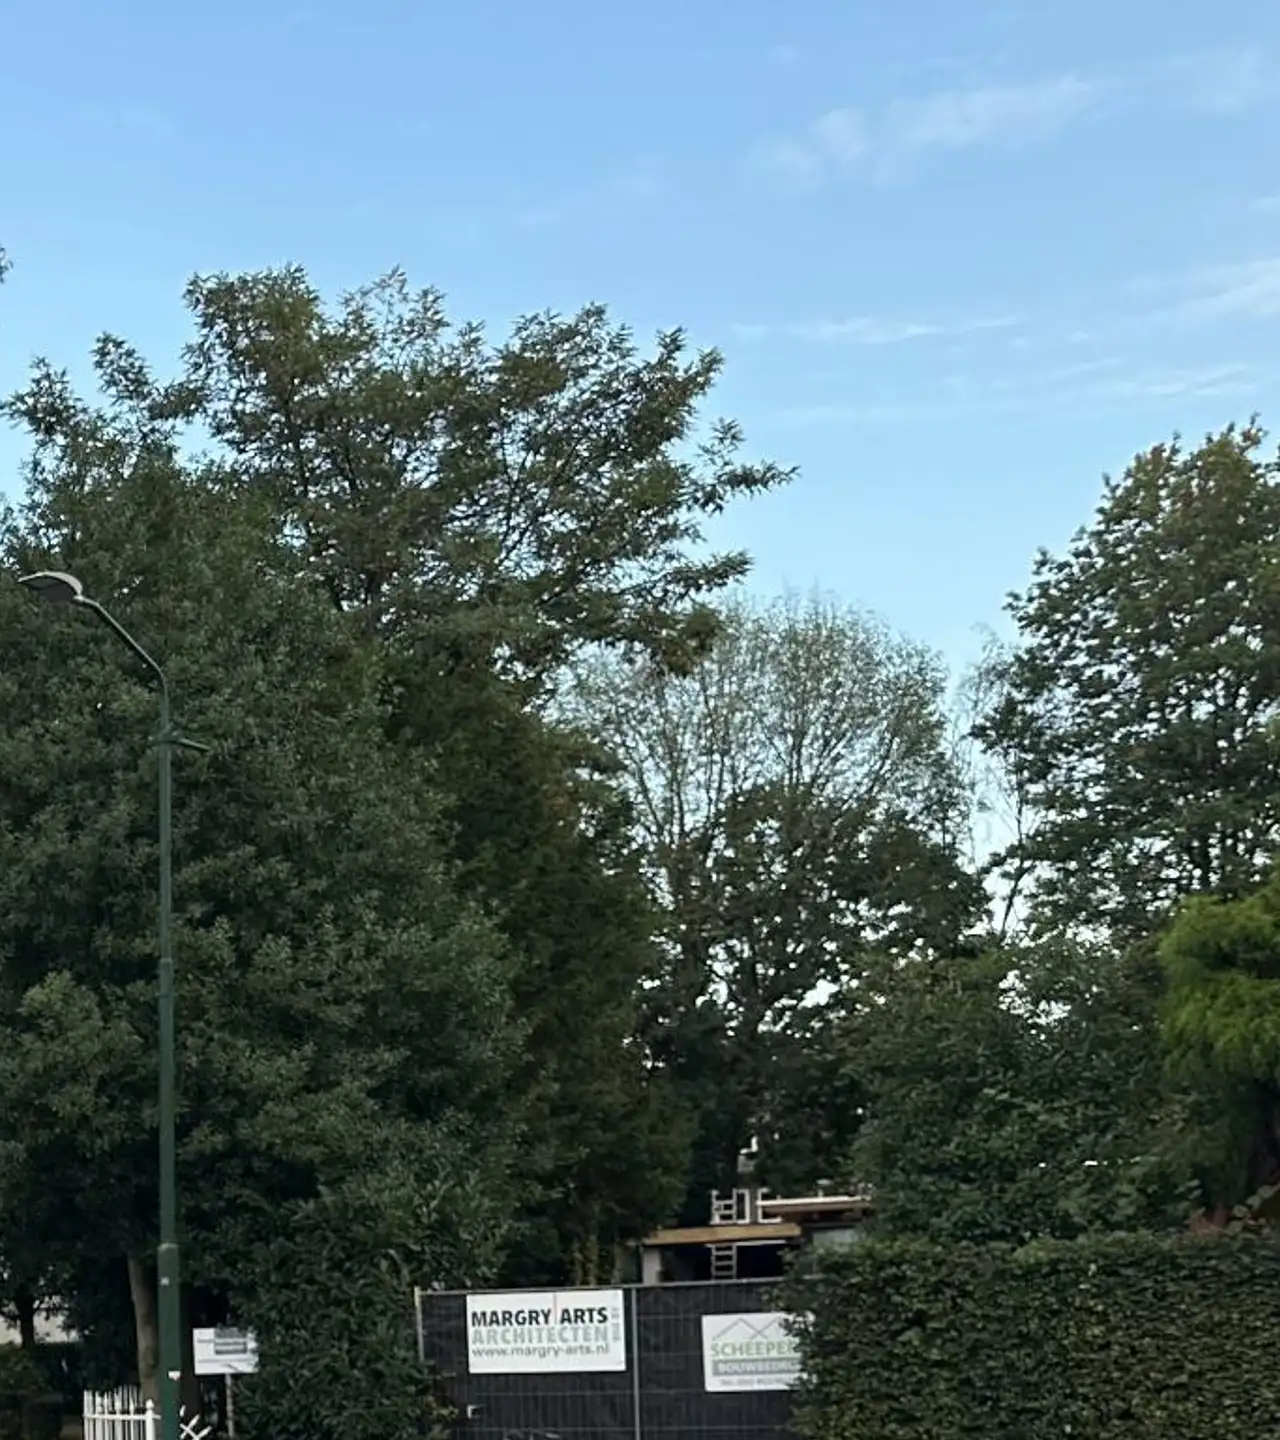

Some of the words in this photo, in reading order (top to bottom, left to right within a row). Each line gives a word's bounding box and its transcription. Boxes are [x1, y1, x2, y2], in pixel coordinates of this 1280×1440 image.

[471, 1308, 551, 1327] MARGRY
[560, 1306, 608, 1324] ARTS
[472, 1325, 608, 1345] ARCHITECTEN
[472, 1343, 609, 1358] www.margry-arts.nl
